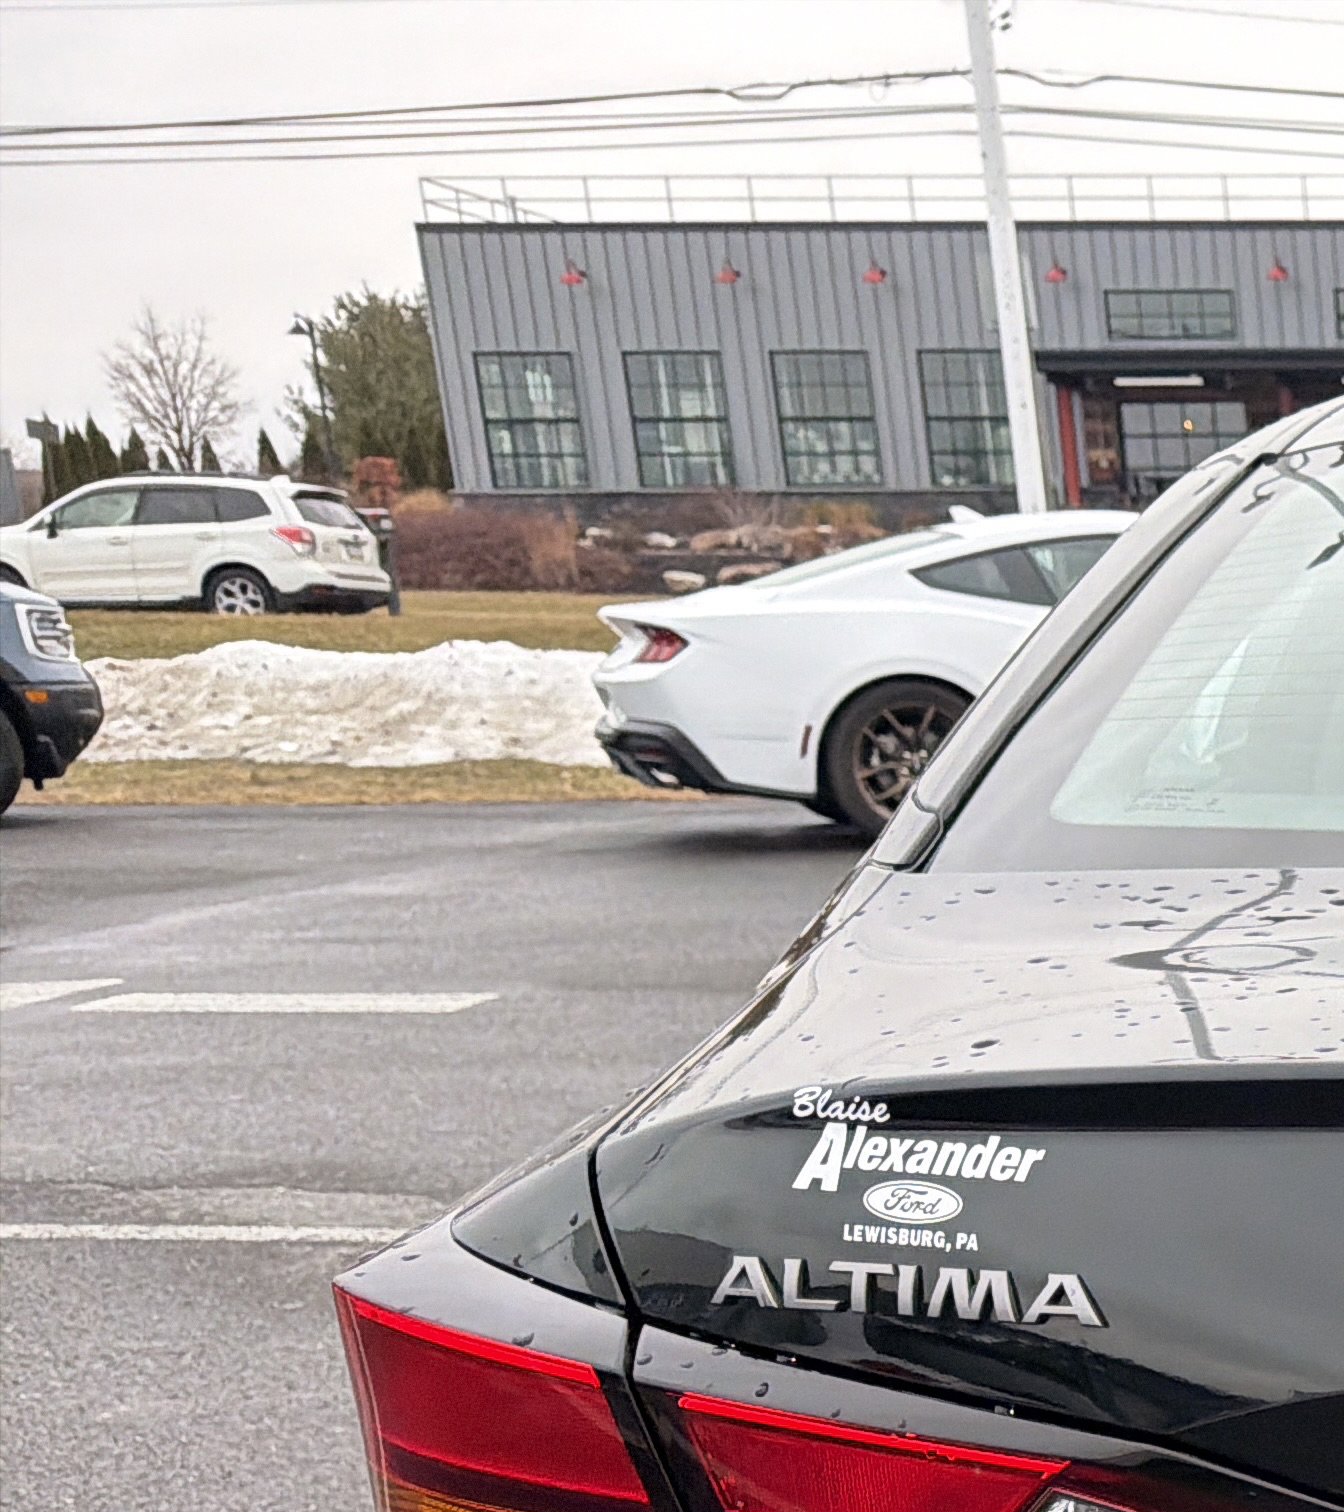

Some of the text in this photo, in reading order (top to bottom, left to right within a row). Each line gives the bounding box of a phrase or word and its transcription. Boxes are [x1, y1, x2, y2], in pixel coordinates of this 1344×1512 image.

[792, 1086, 891, 1123] Blaise
[792, 1122, 1046, 1192] Alexander
[884, 1188, 940, 1216] Ford
[842, 1223, 979, 1252] LEWISBURG, PA
[710, 1256, 1110, 1328] ALTIMA
